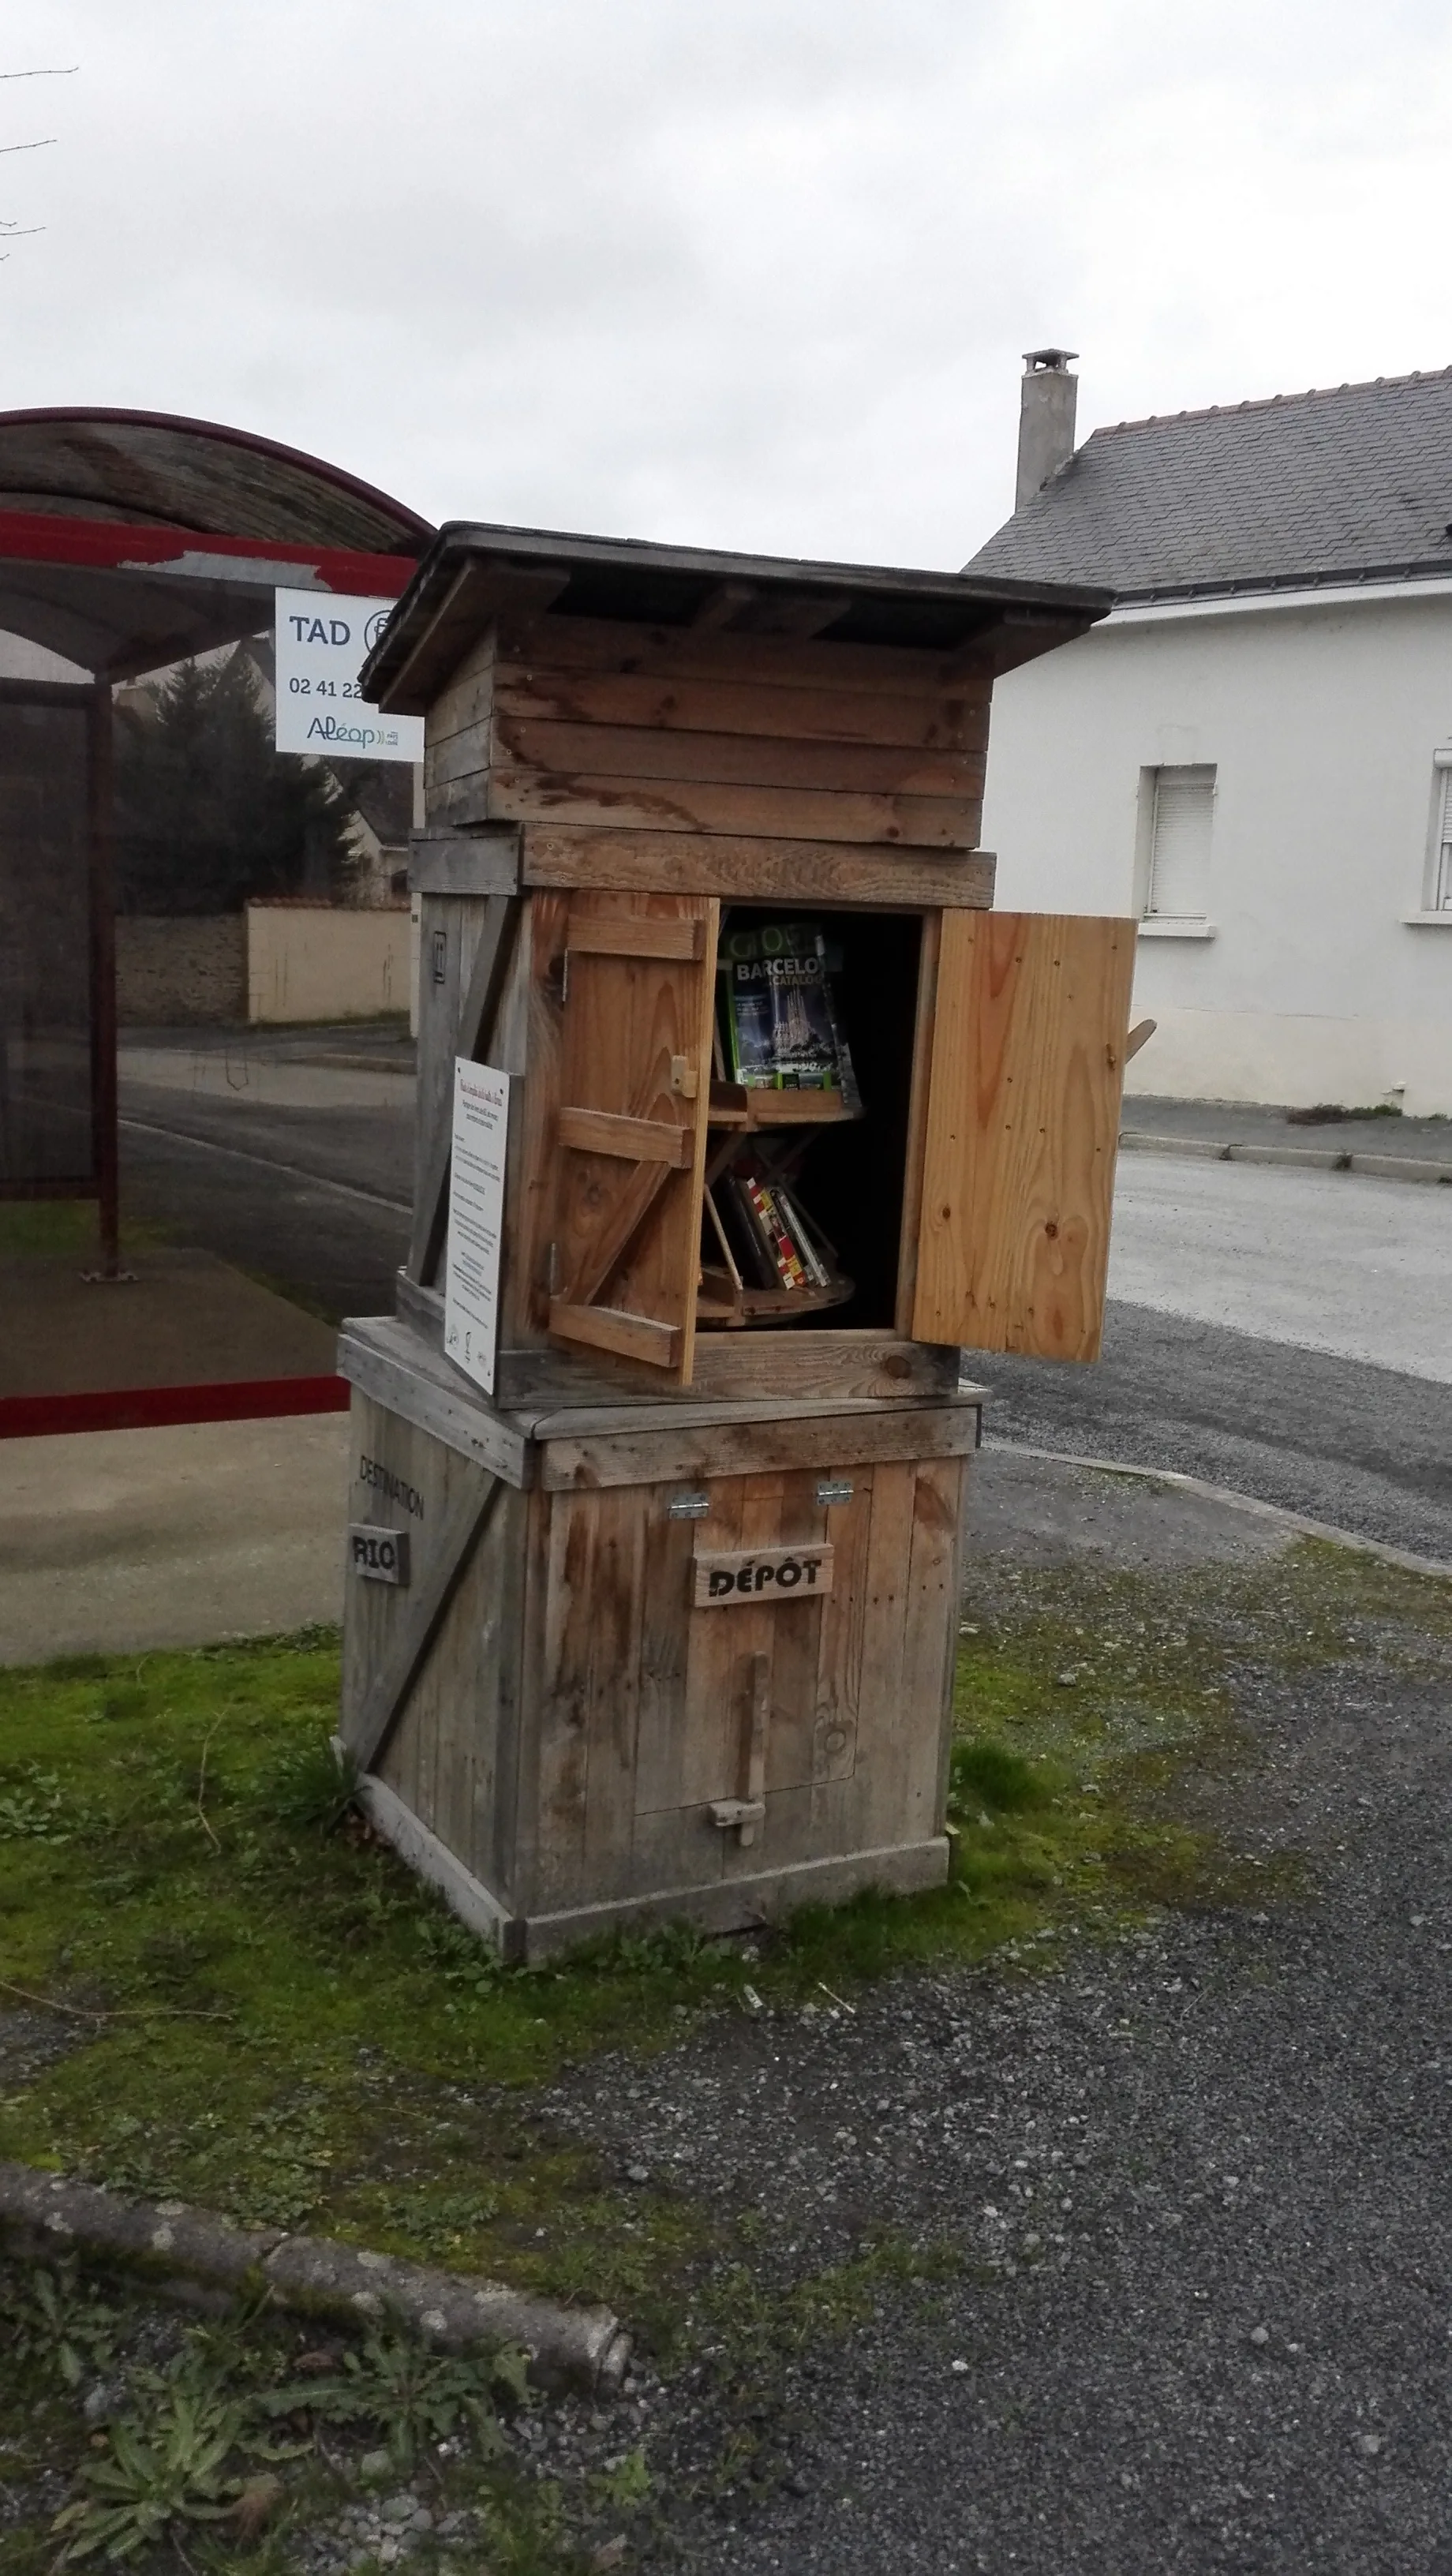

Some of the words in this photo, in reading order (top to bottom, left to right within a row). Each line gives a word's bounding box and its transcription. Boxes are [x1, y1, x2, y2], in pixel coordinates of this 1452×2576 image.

[289, 616, 350, 646] TAD
[290, 678, 311, 695] 02
[316, 680, 337, 697] 41
[342, 683, 363, 698] 22
[307, 717, 375, 749] Aléop
[736, 957, 818, 981] BARCELO
[360, 1455, 425, 1521] DESTINATION
[353, 1536, 395, 1570] RIO
[709, 1556, 821, 1597] DÉPÔT
